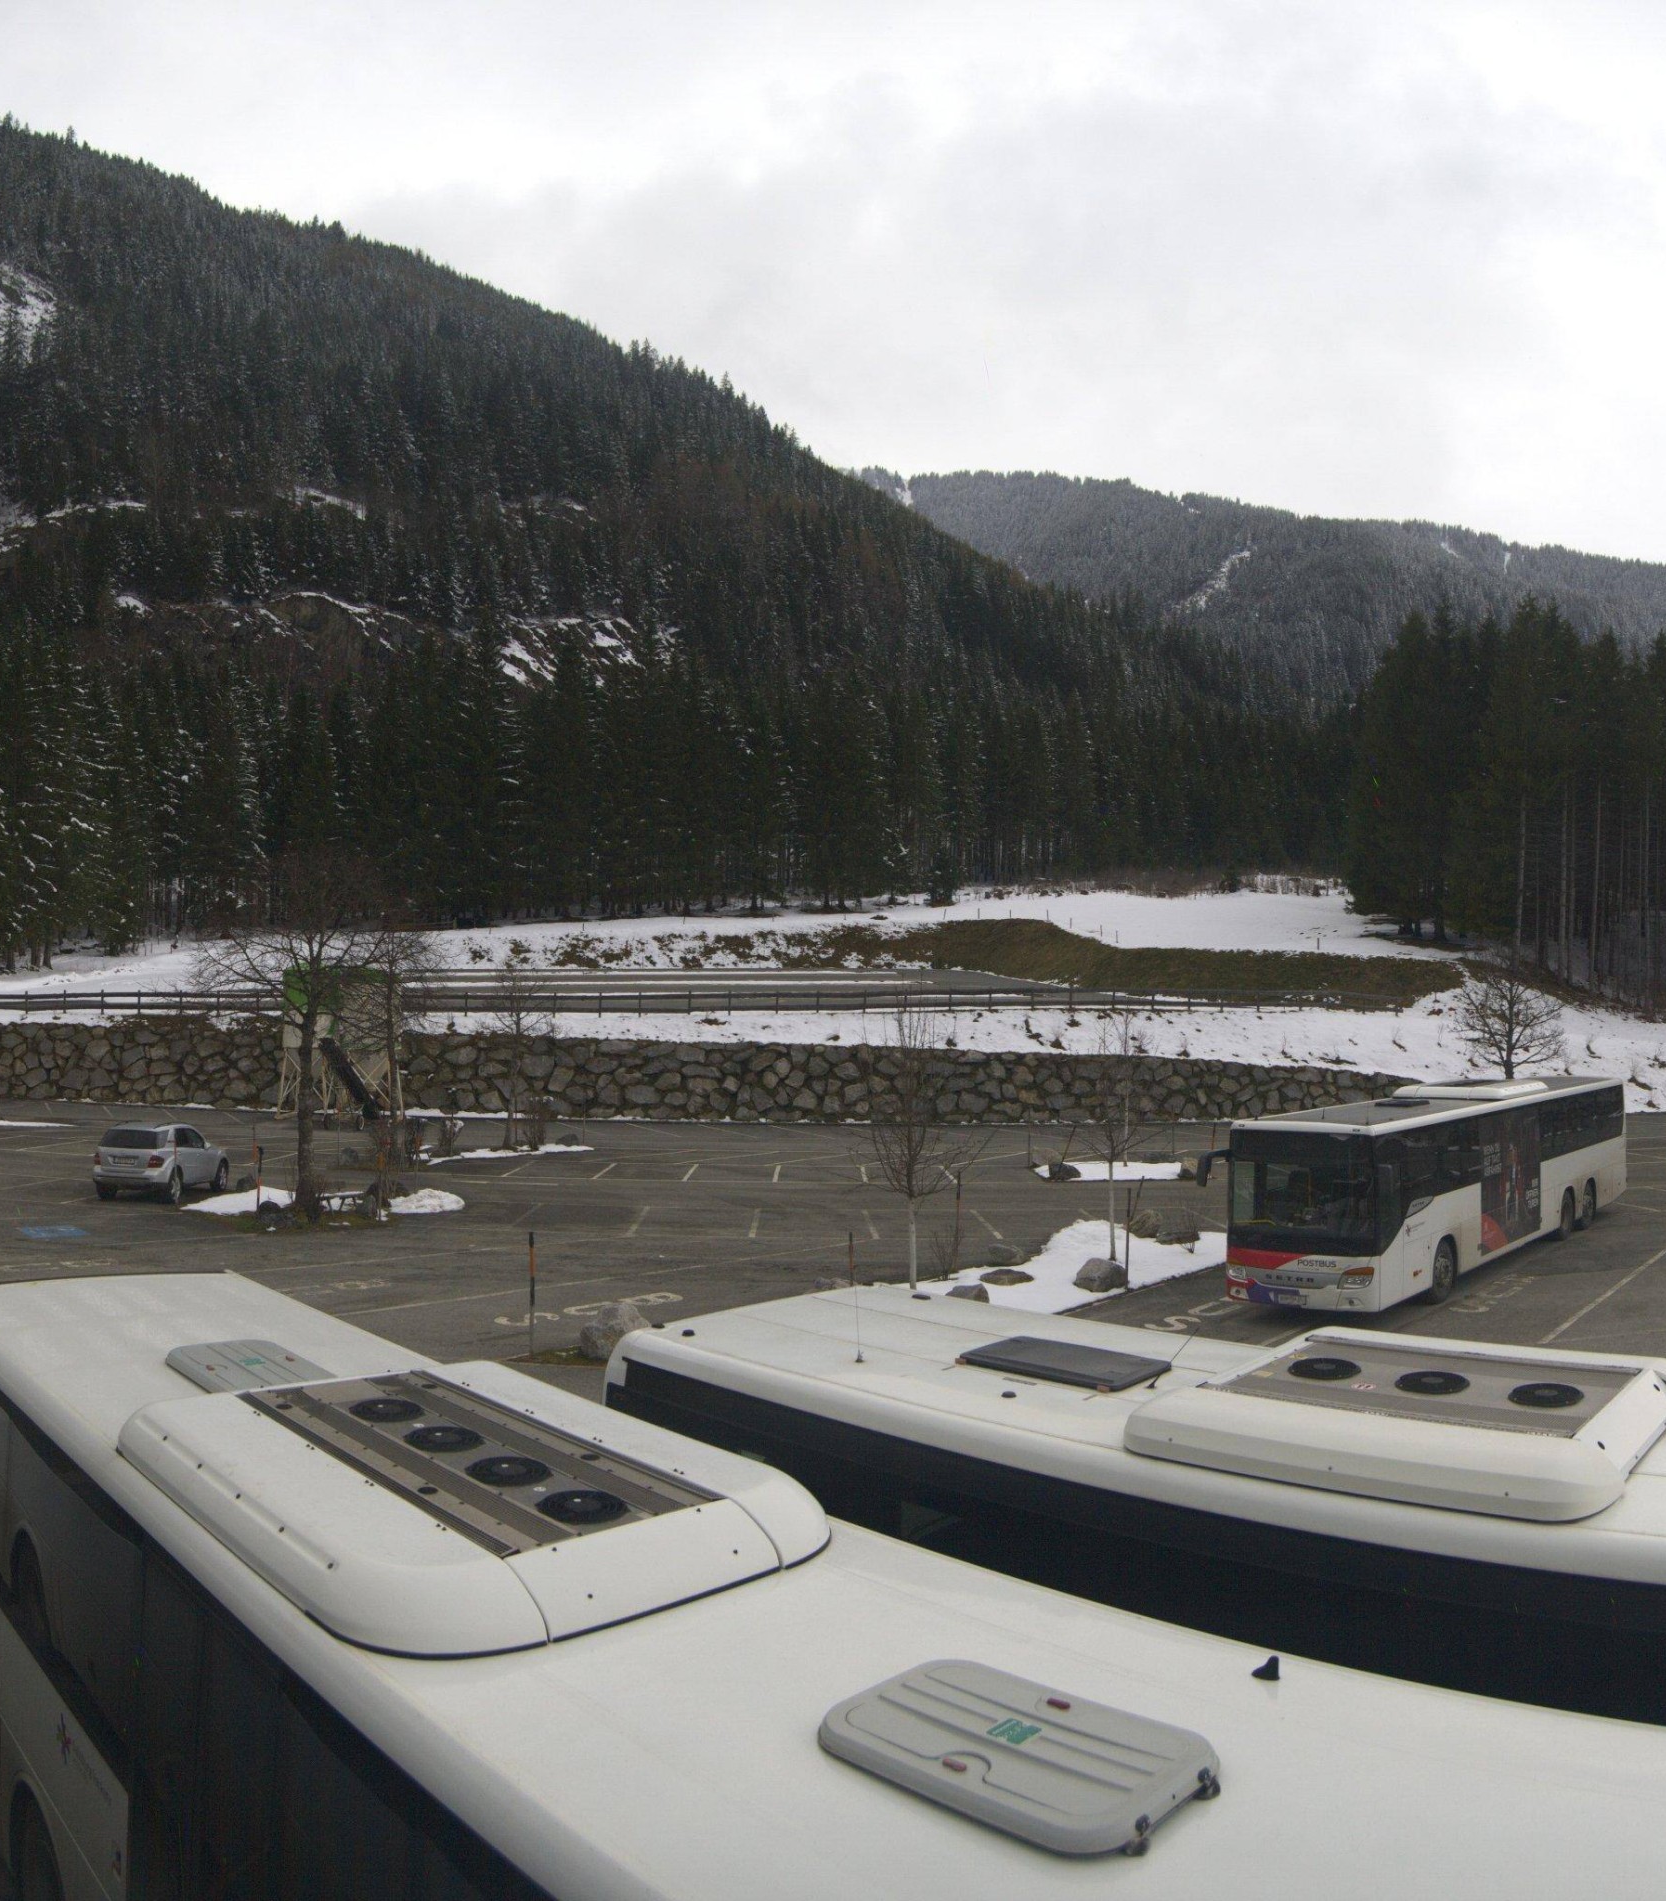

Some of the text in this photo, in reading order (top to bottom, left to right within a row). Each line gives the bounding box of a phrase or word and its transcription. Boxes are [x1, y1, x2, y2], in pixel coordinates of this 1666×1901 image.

[1297, 1258, 1337, 1268] POSTBUS
[1265, 1273, 1315, 1283] SETRA
[1144, 1297, 1243, 1330] US
